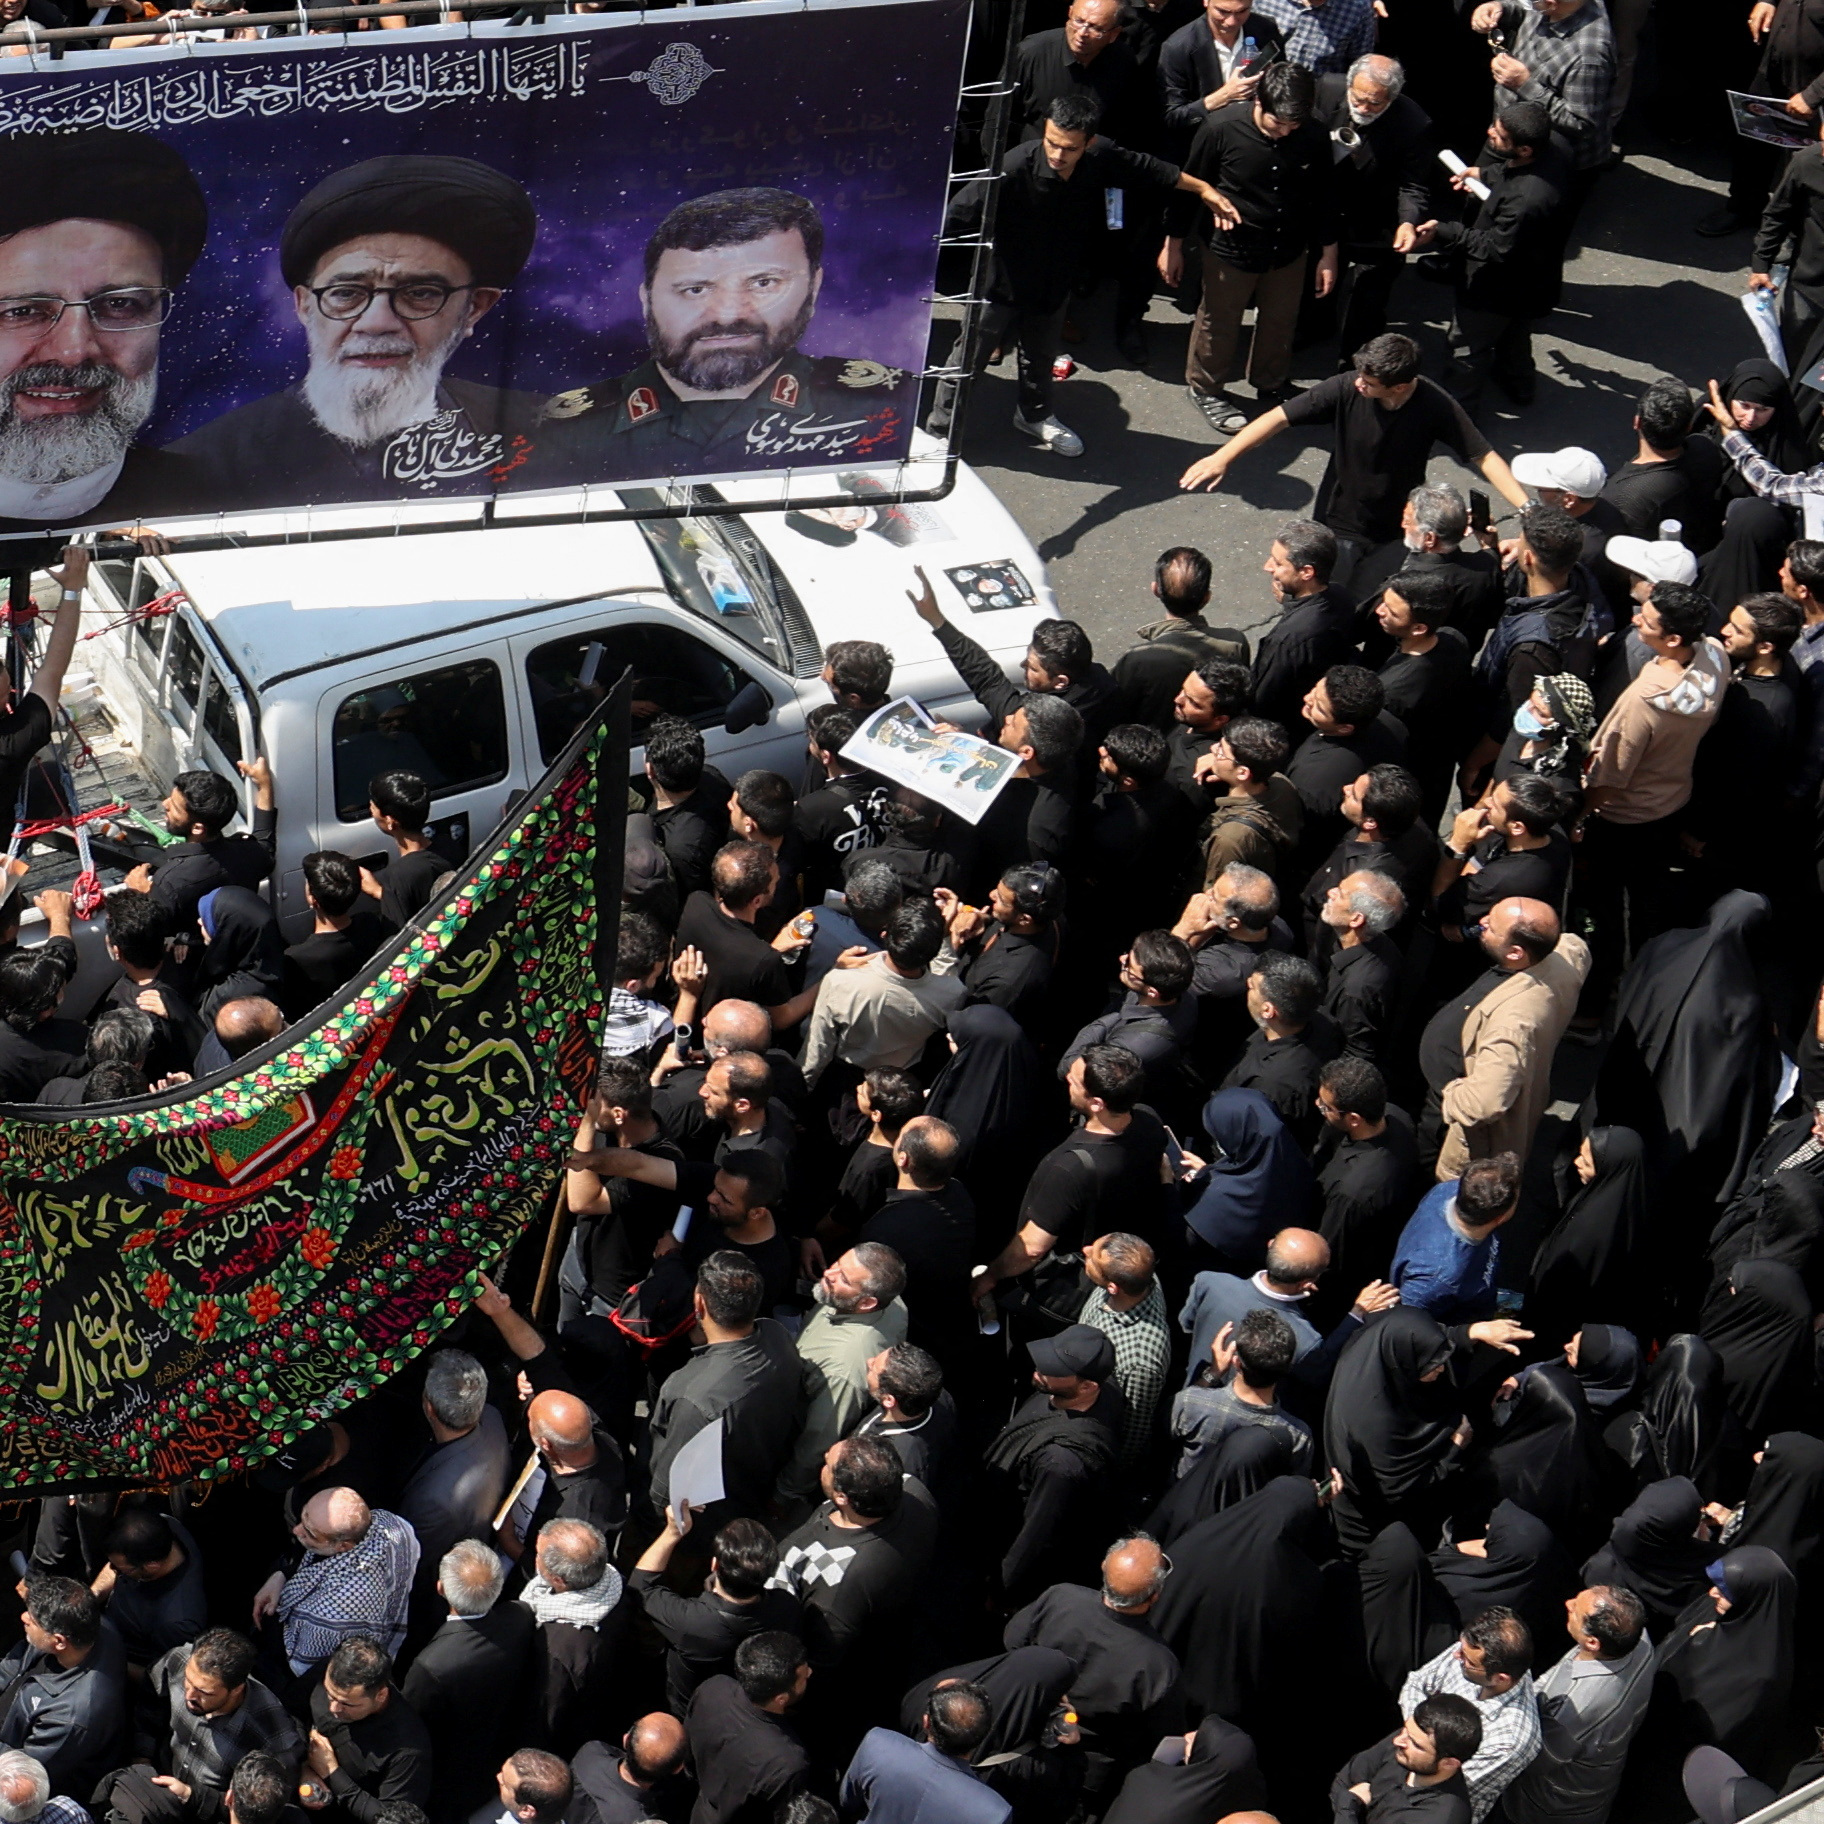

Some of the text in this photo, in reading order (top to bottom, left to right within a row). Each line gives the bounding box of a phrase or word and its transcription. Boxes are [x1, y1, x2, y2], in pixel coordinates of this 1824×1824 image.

[745, 412, 795, 455] موسوی
[851, 407, 902, 454] شهید
[483, 435, 535, 483] شهید
